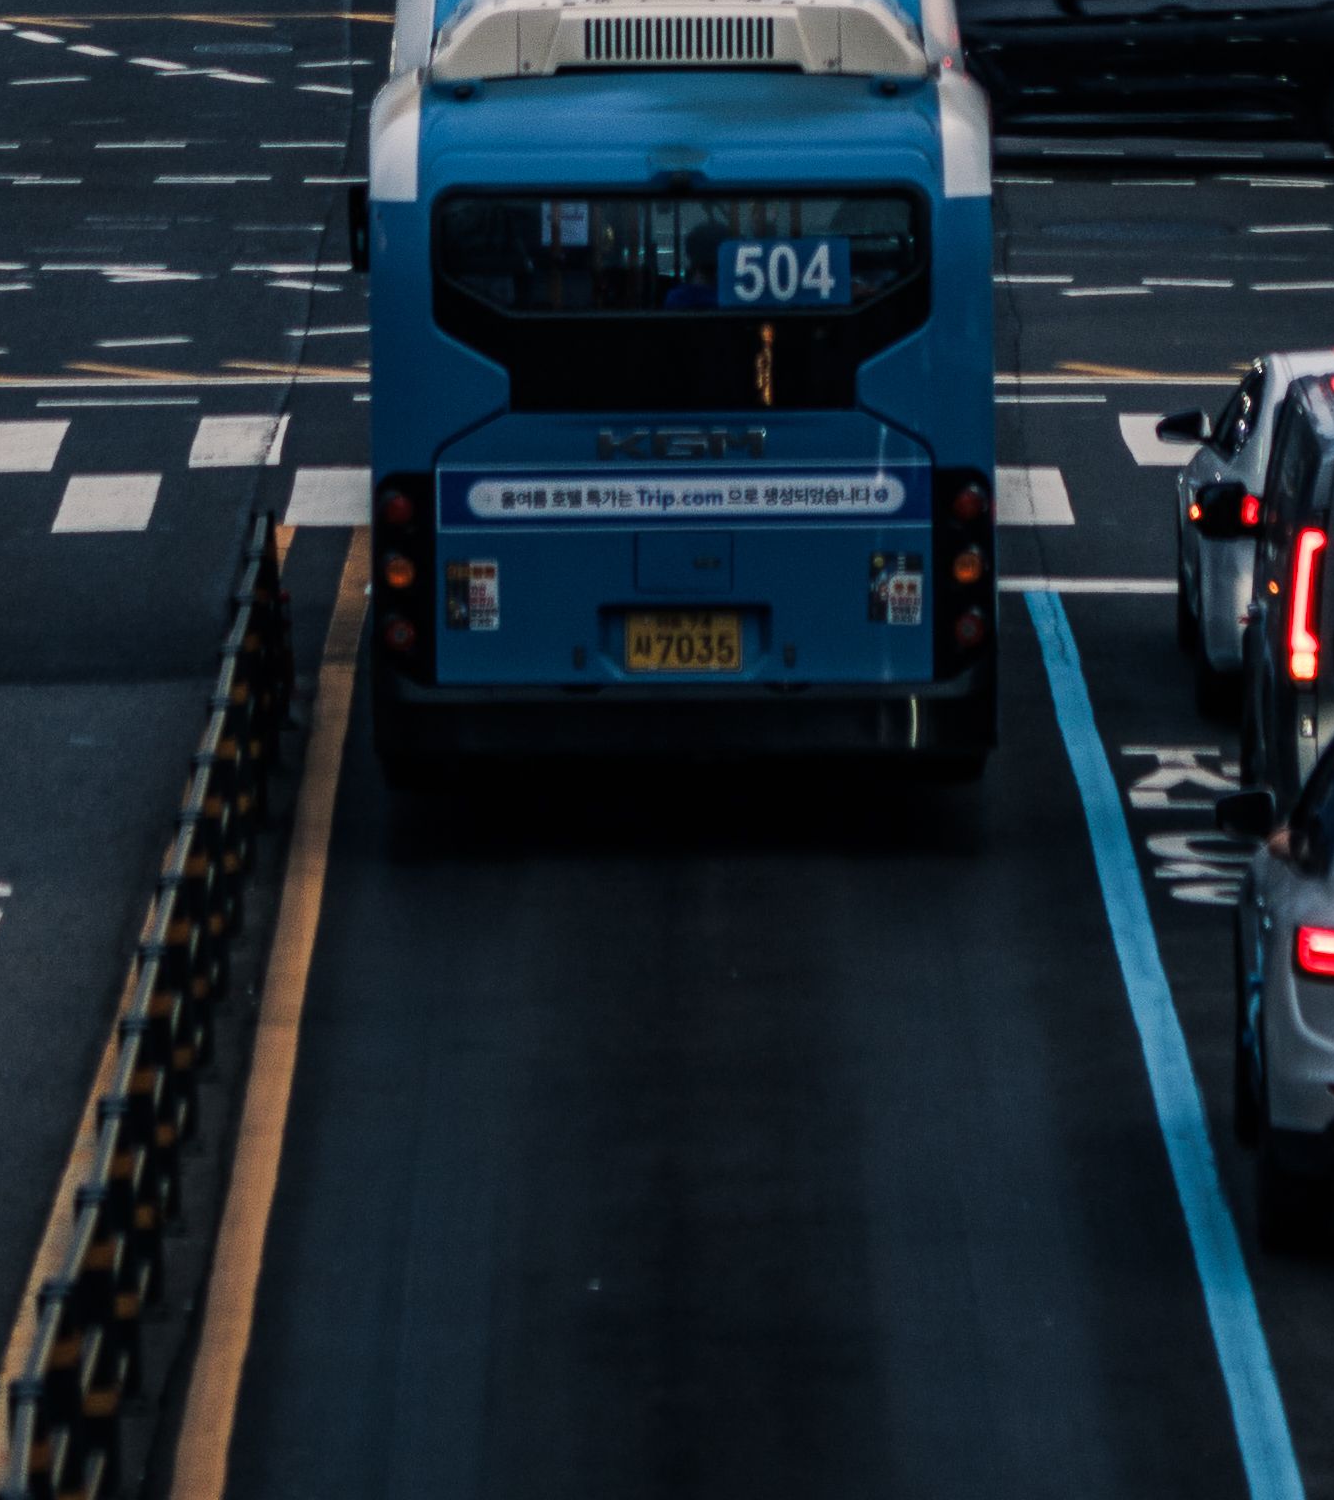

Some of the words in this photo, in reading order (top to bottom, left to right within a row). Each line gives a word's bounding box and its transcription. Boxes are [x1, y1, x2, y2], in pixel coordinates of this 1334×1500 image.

[733, 240, 836, 303] 504
[597, 425, 767, 461] KGM
[552, 489, 582, 507] 호텔
[585, 488, 632, 508] 특가는
[637, 487, 723, 510] Trip.com
